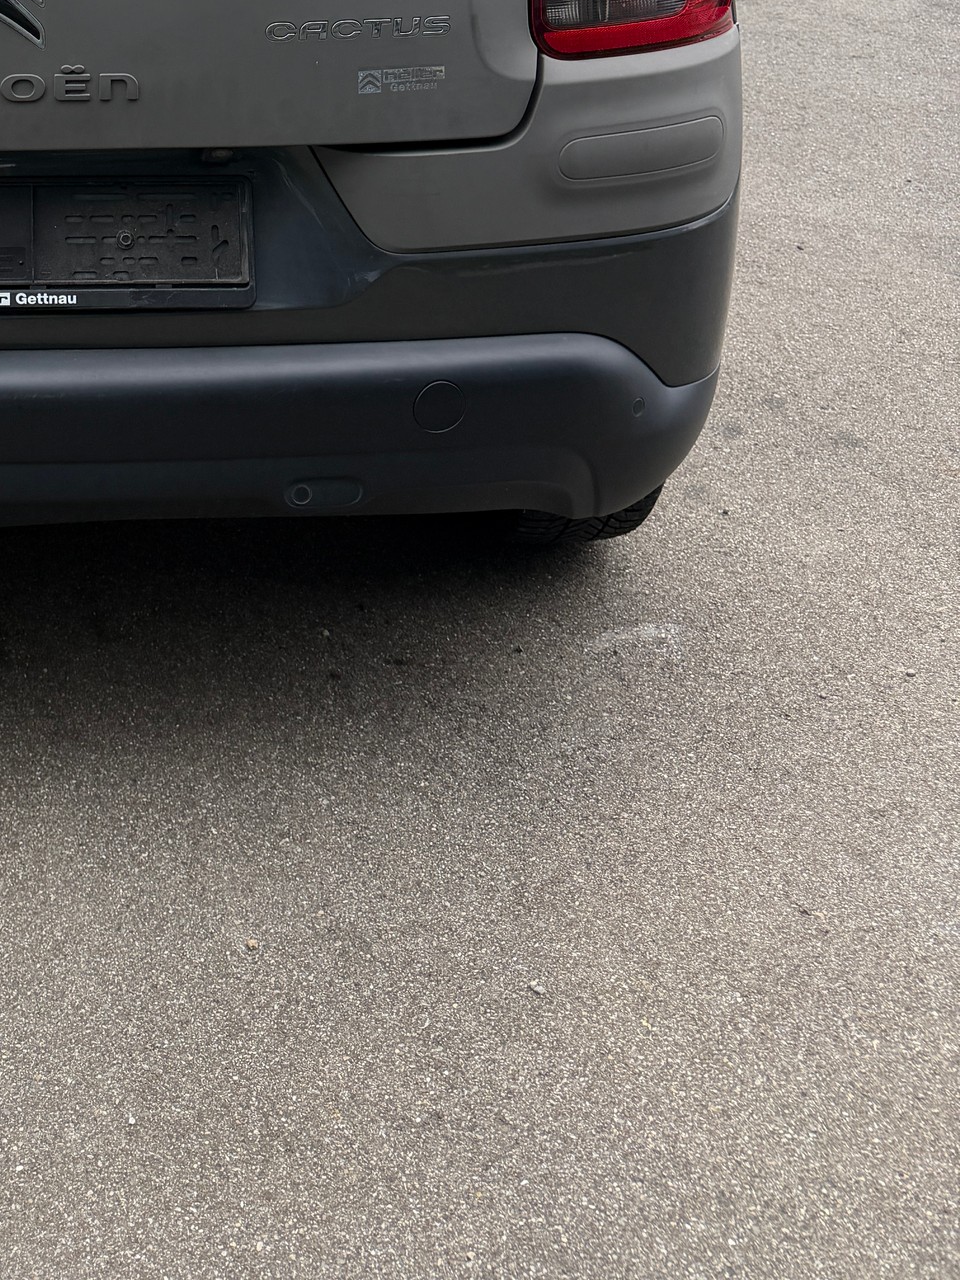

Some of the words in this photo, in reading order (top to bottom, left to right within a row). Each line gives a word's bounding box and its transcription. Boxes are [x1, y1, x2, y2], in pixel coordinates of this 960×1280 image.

[265, 15, 451, 42] CACTUS
[390, 81, 438, 92] Gettnau
[15, 293, 77, 305] Gettnau
